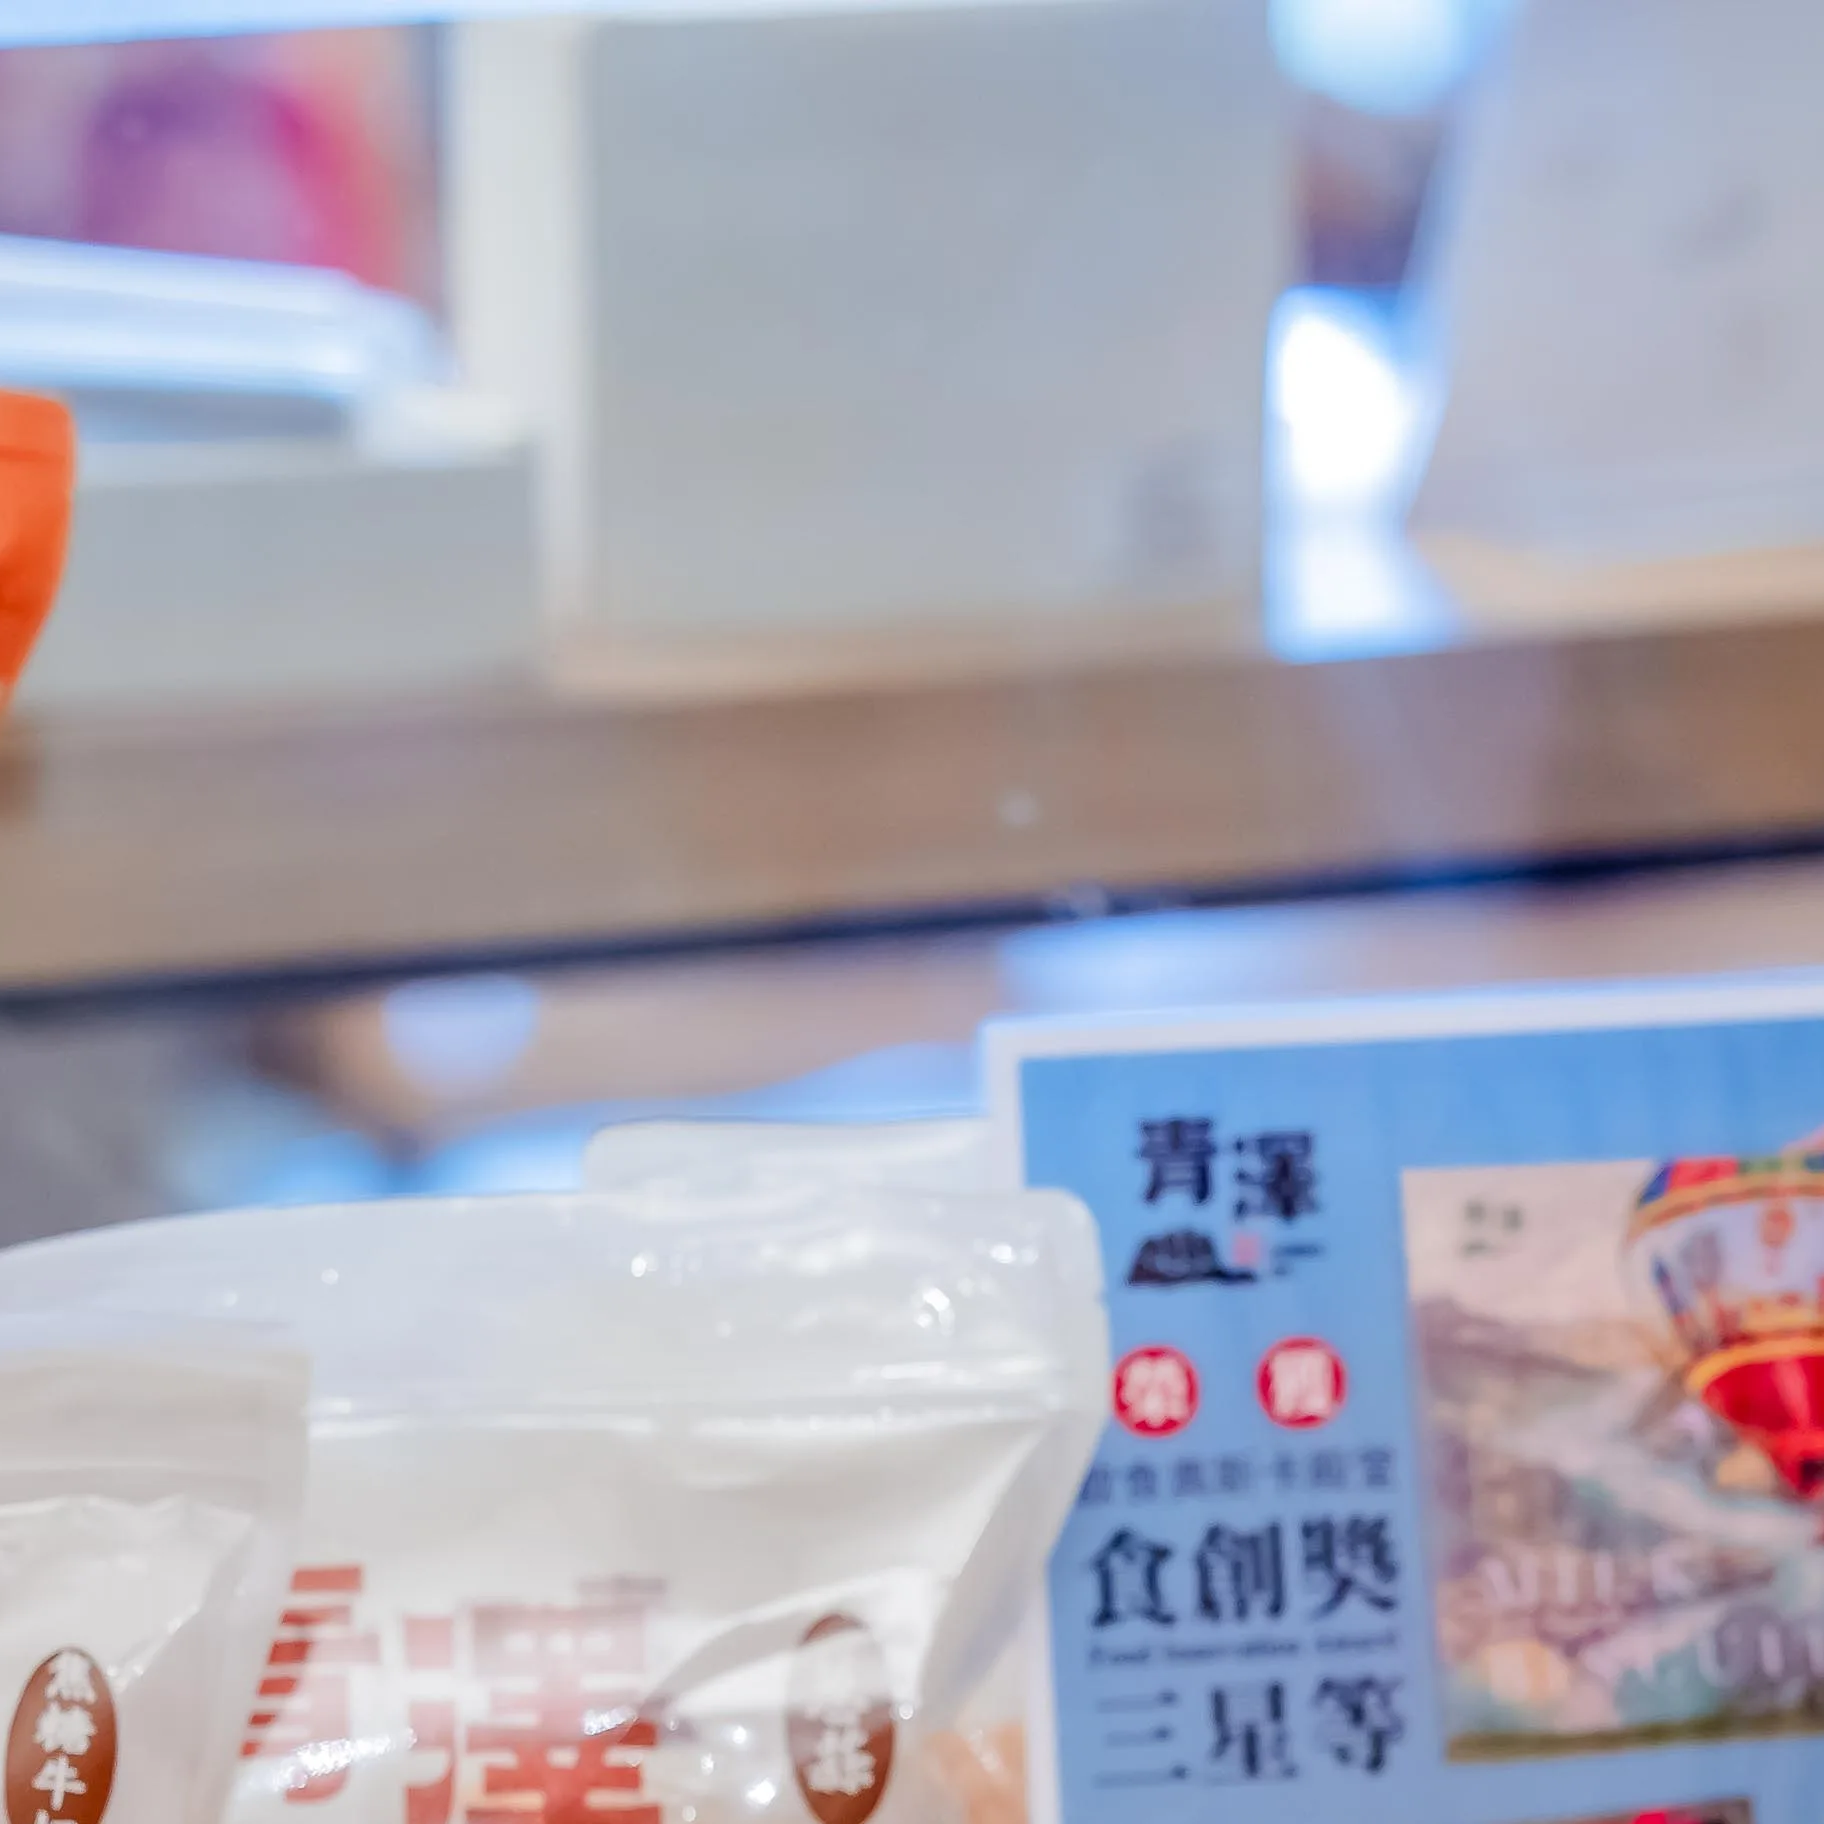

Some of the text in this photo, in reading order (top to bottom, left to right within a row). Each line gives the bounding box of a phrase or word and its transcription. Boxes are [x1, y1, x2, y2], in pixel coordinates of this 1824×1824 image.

[1087, 1513, 1398, 1633] 食創獎
[1093, 1674, 1406, 1787] 三星等
